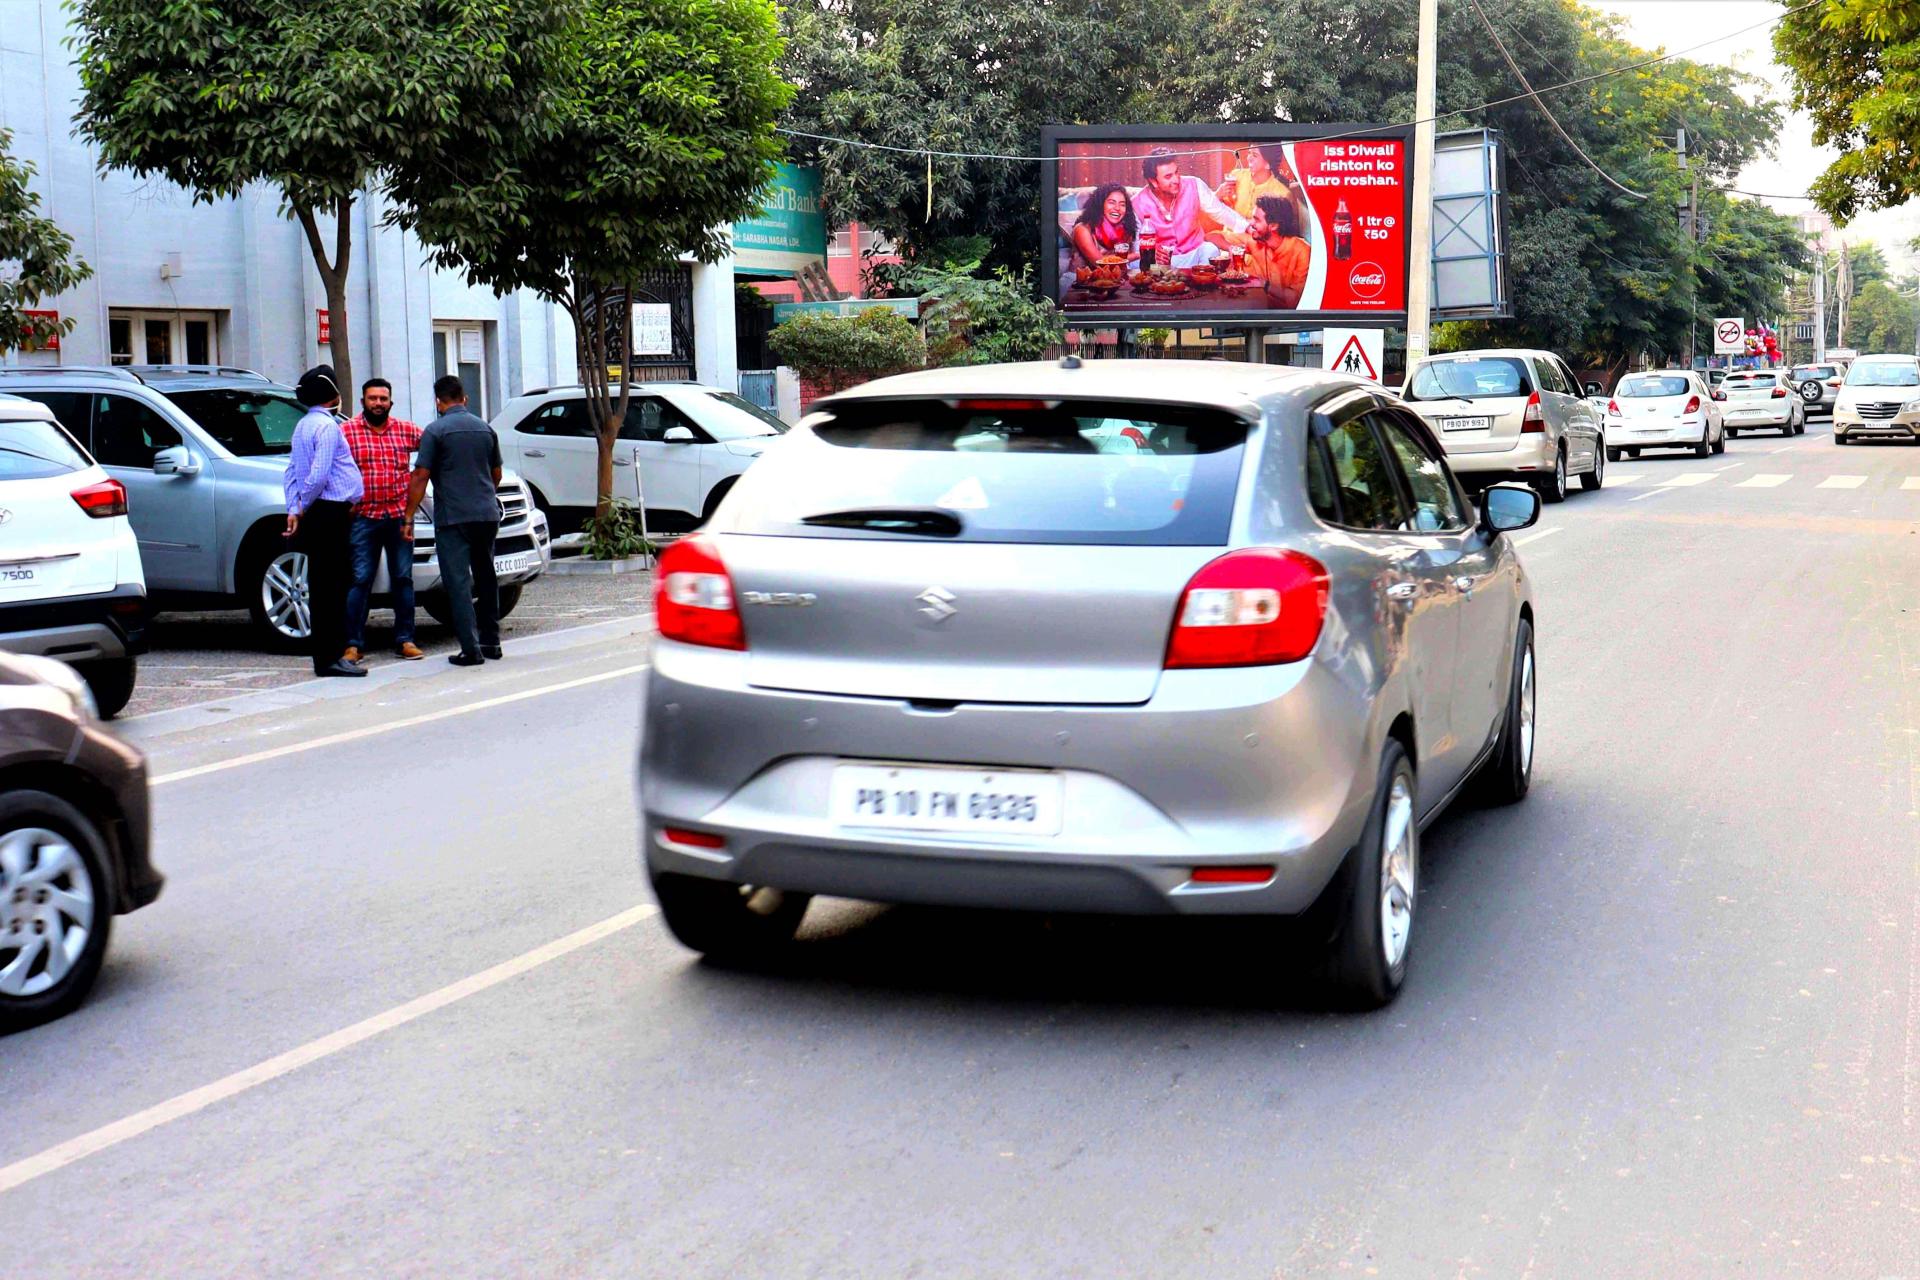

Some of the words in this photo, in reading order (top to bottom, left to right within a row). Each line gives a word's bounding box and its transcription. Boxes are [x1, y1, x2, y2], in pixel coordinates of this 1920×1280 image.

[1324, 145, 1345, 156] Iss
[1348, 144, 1395, 156] Diwali
[1320, 159, 1372, 171] rishton
[1376, 159, 1395, 171] ko
[1307, 174, 1340, 186] karo
[1343, 174, 1399, 186] roshan.
[787, 187, 817, 213] Bank
[1357, 216, 1364, 226] 1
[1367, 216, 1382, 226] ltr
[1364, 229, 1388, 239] ₹50
[2, 570, 33, 581] 7500
